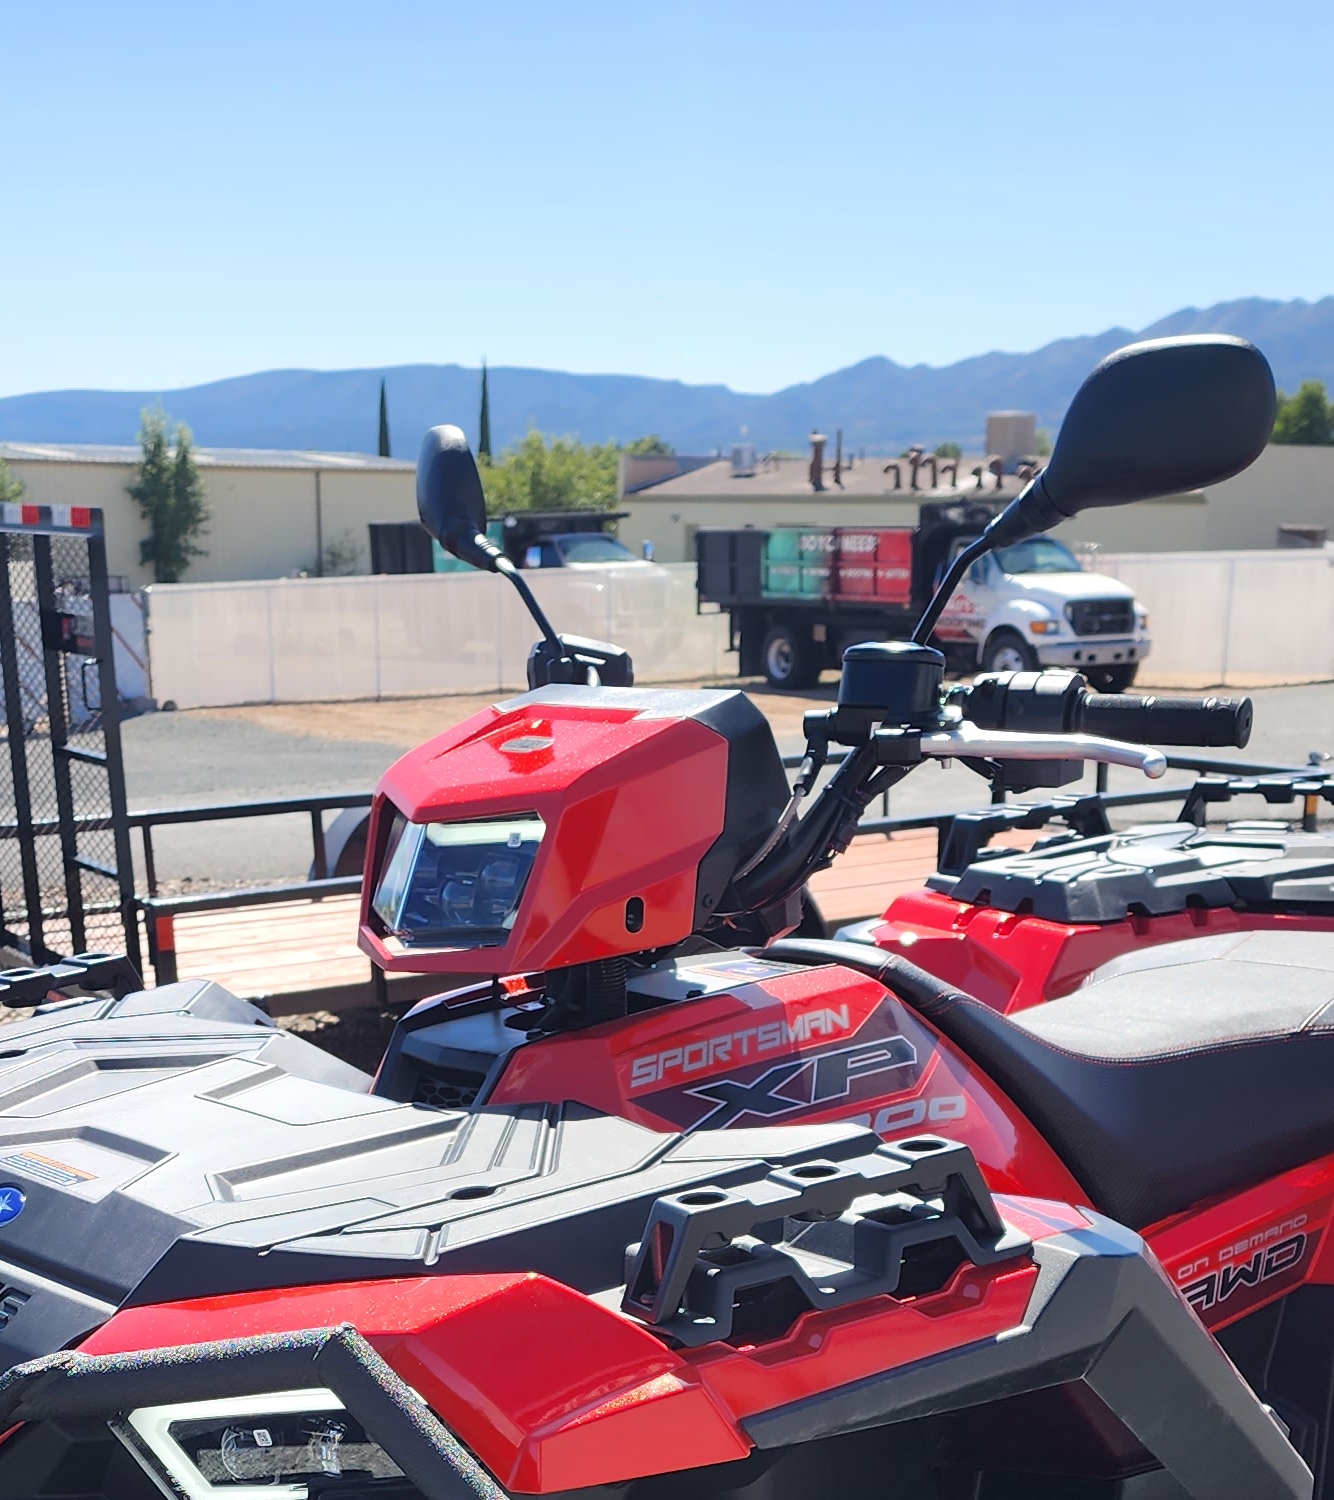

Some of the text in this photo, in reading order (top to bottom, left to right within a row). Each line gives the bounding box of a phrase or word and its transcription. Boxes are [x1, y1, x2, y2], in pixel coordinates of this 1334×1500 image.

[630, 1004, 850, 1088] SPORTSMAN
[681, 1034, 918, 1137] XP
[832, 1095, 967, 1134] 00
[1177, 1213, 1308, 1281] ON DEMAND
[1180, 1231, 1308, 1311] AWD
